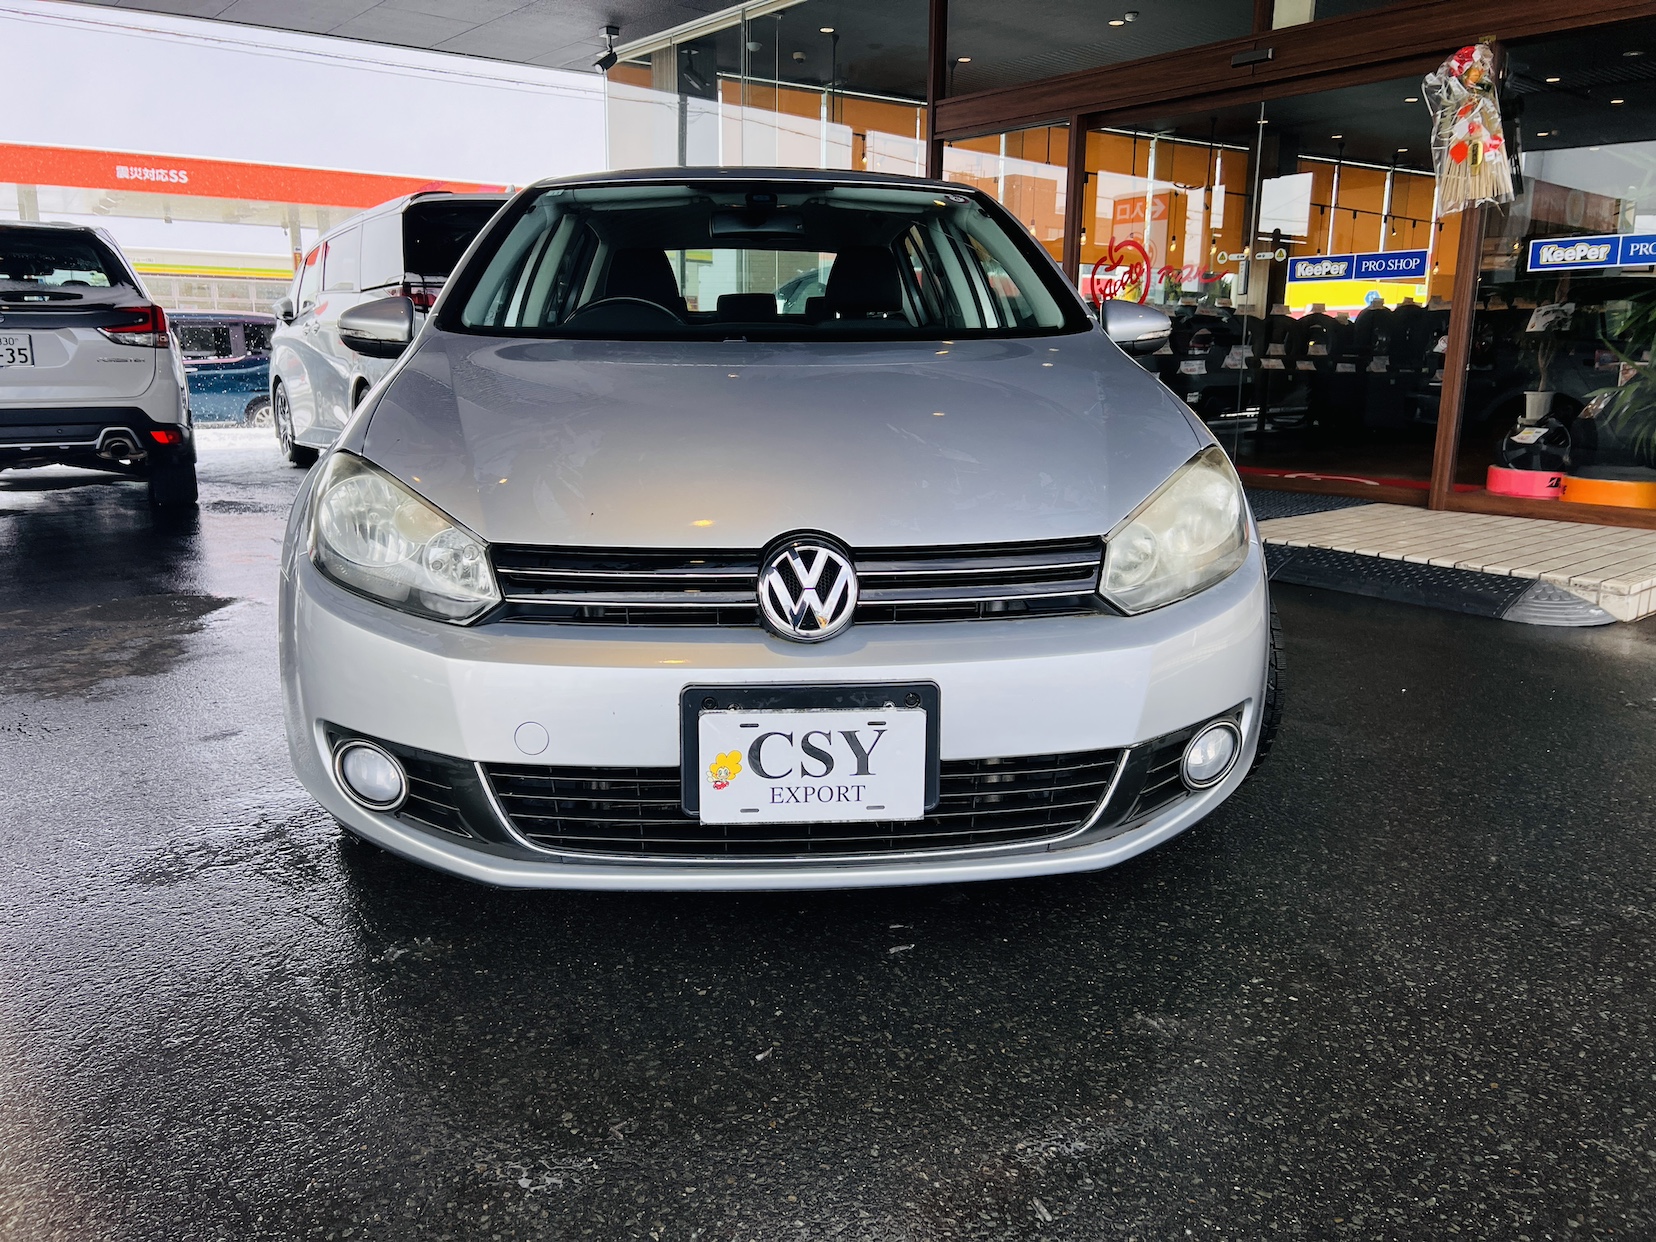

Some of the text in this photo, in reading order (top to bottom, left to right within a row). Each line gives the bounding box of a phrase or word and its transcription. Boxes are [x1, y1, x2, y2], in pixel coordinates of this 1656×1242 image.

[115, 165, 189, 184] 震災対応SS
[1541, 243, 1610, 263] KeePer
[1296, 258, 1420, 277] KeePer PRO SHOP
[747, 729, 888, 780] CSY
[769, 785, 866, 804] EXPORT
